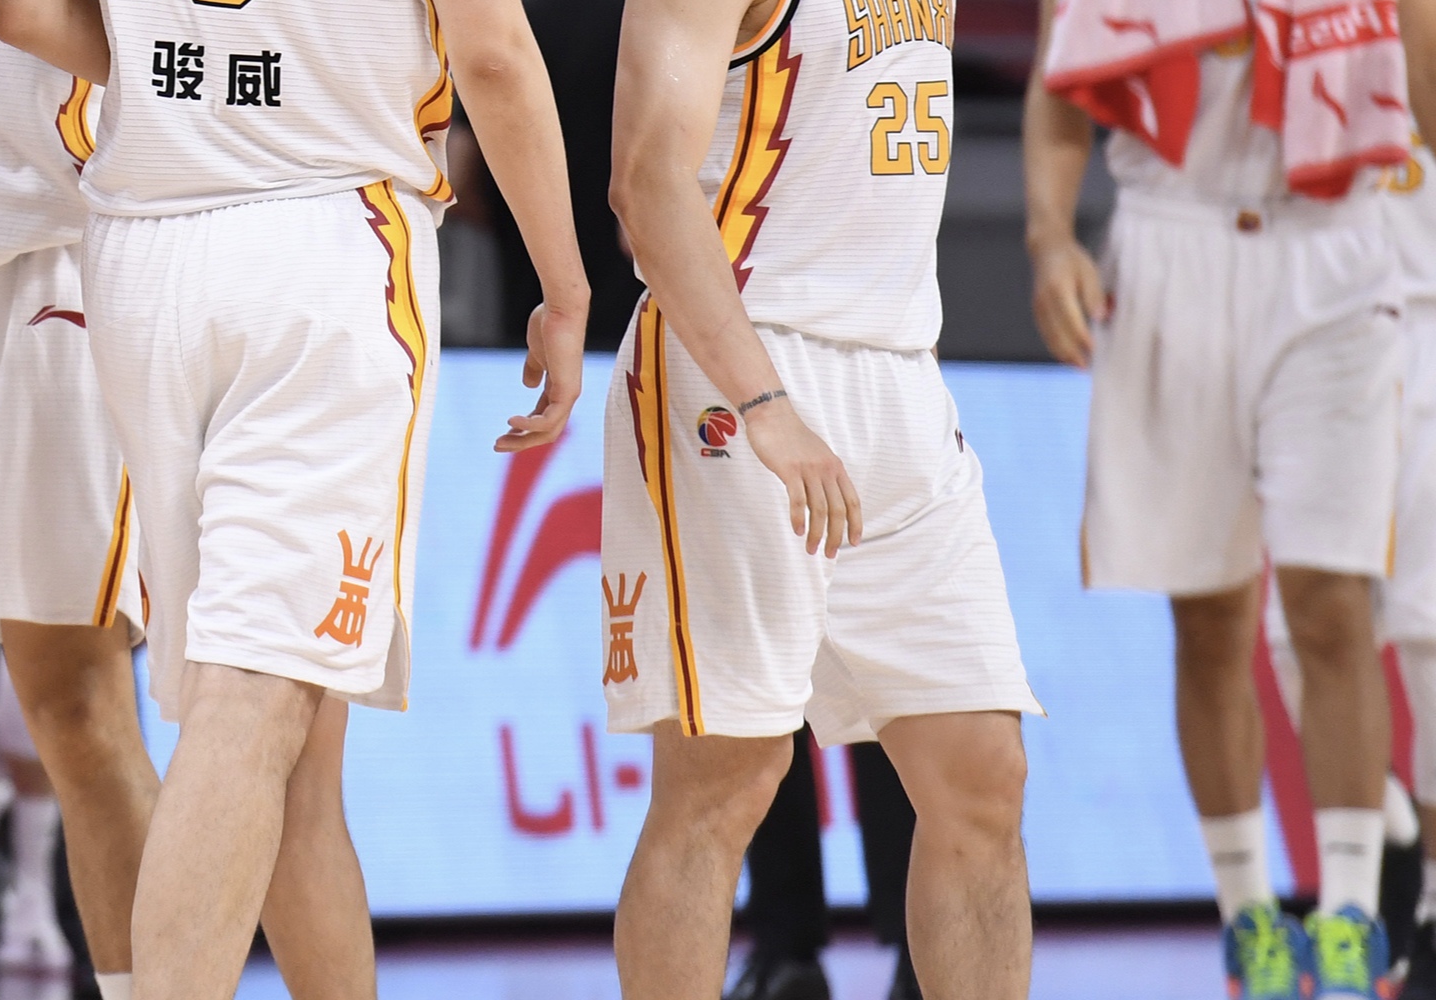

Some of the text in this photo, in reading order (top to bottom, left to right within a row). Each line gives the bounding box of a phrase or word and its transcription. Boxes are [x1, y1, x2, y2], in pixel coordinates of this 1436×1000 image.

[151, 40, 282, 107] 骏威
[866, 80, 952, 176] 25
[700, 447, 732, 459] CBA
